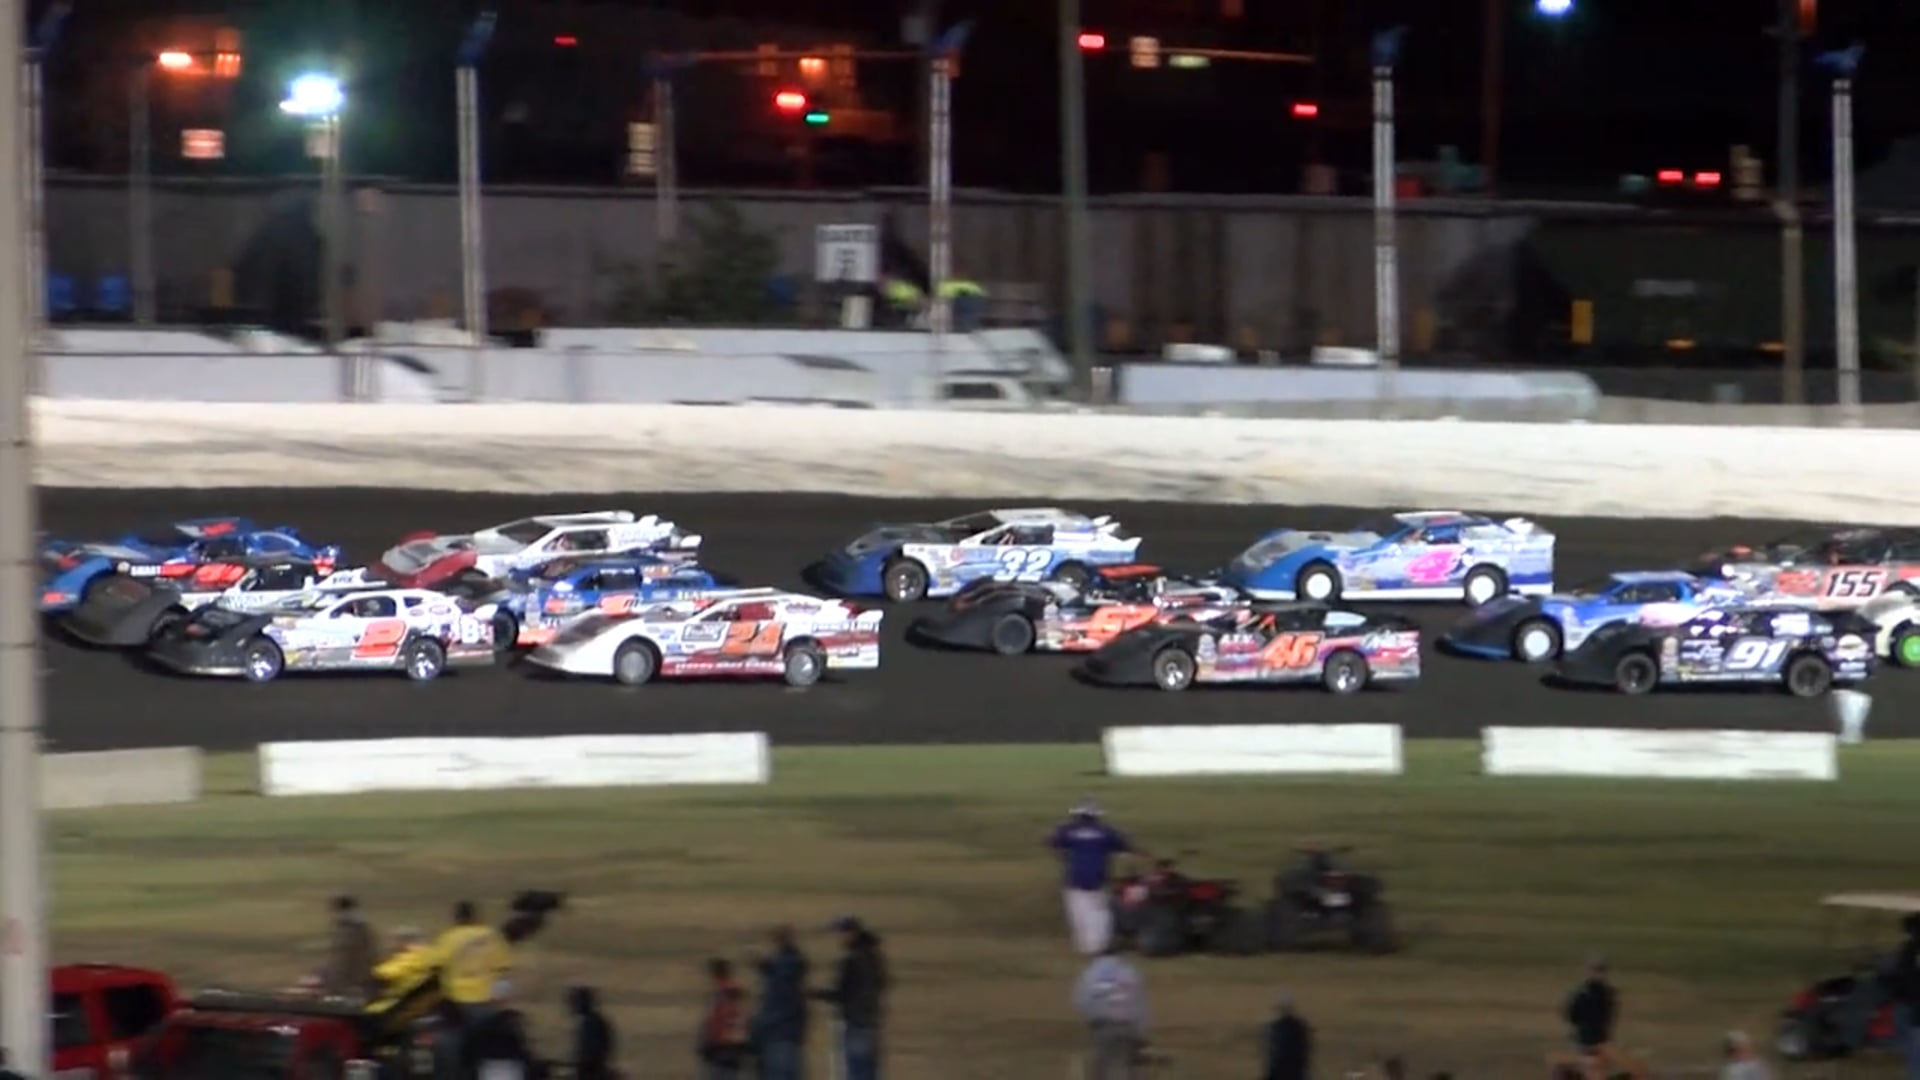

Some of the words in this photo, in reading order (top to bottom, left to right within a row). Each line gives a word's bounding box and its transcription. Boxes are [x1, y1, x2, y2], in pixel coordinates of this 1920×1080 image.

[994, 548, 1052, 582] 32
[1826, 571, 1882, 597] 155
[354, 620, 407, 658] 2
[1263, 631, 1322, 668] 46
[1725, 638, 1790, 671] 91
